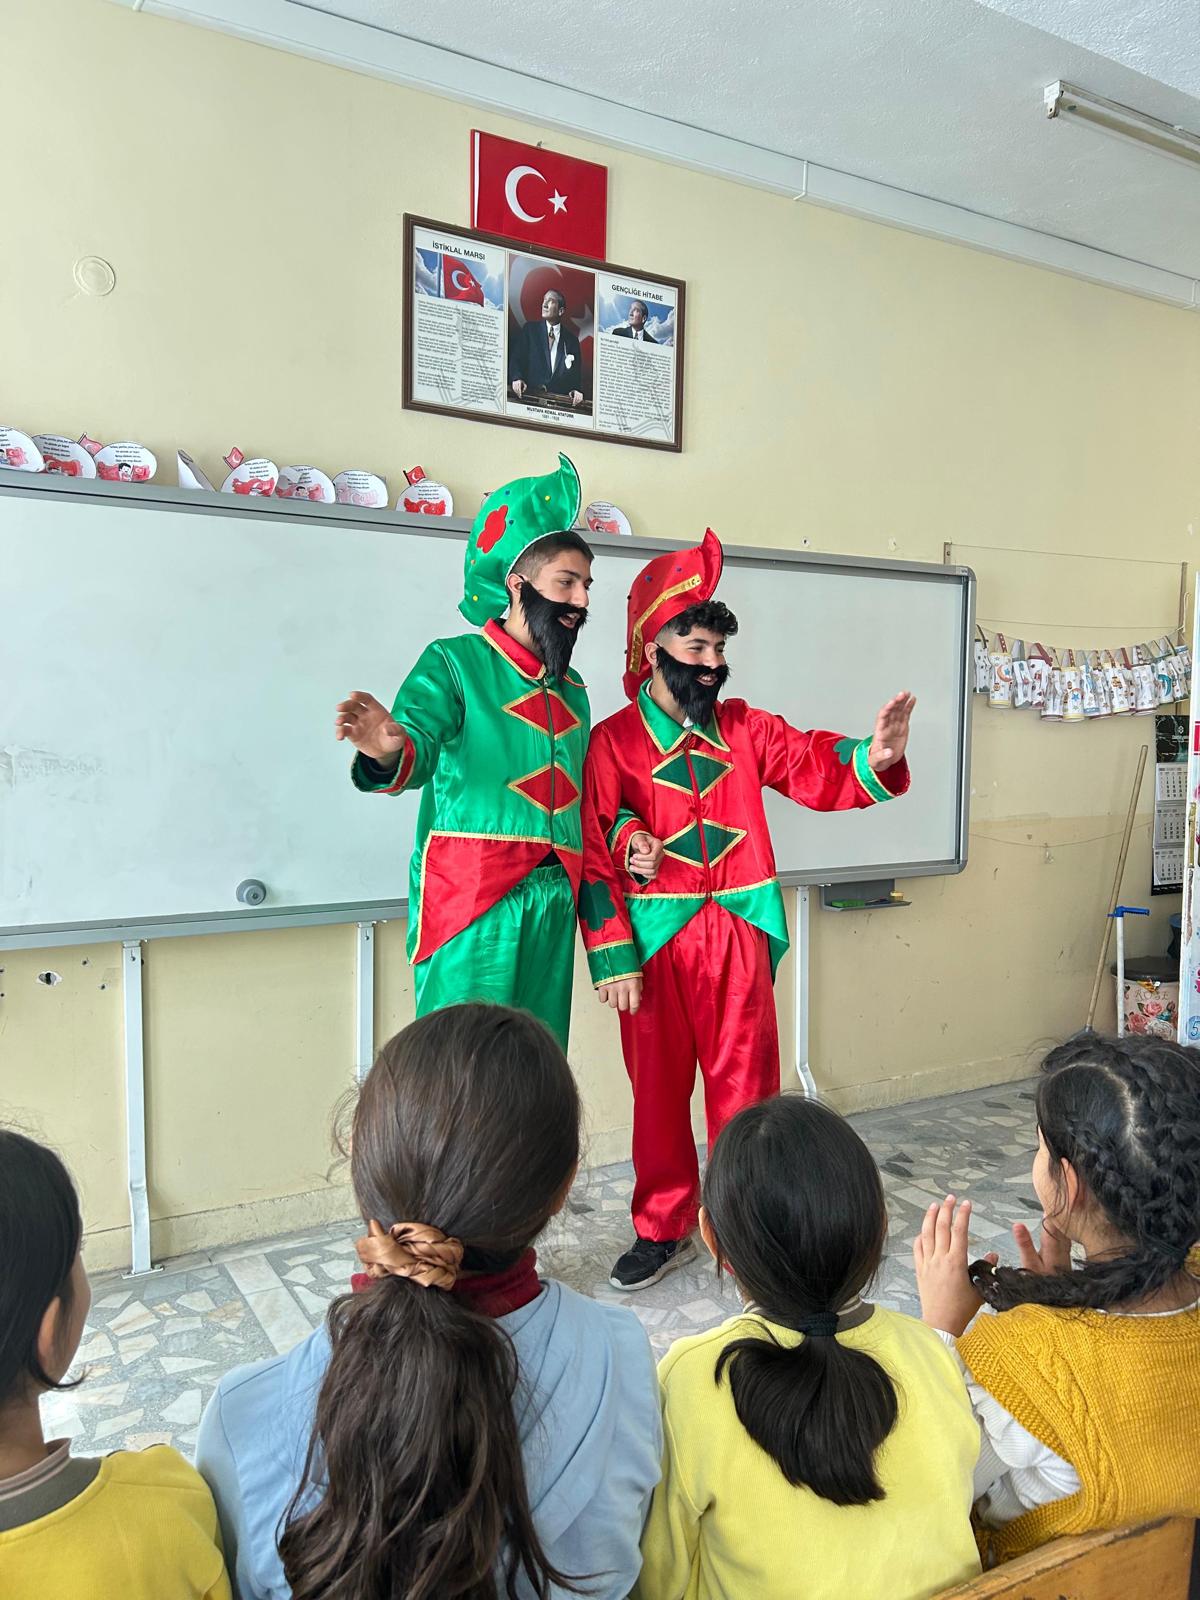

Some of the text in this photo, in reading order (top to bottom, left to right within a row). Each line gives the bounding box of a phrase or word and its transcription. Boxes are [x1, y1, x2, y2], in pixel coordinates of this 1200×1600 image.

[432, 240, 486, 261] İSTİKLAL MARŞI
[611, 284, 664, 302] GENÇLİĞE HİTABE
